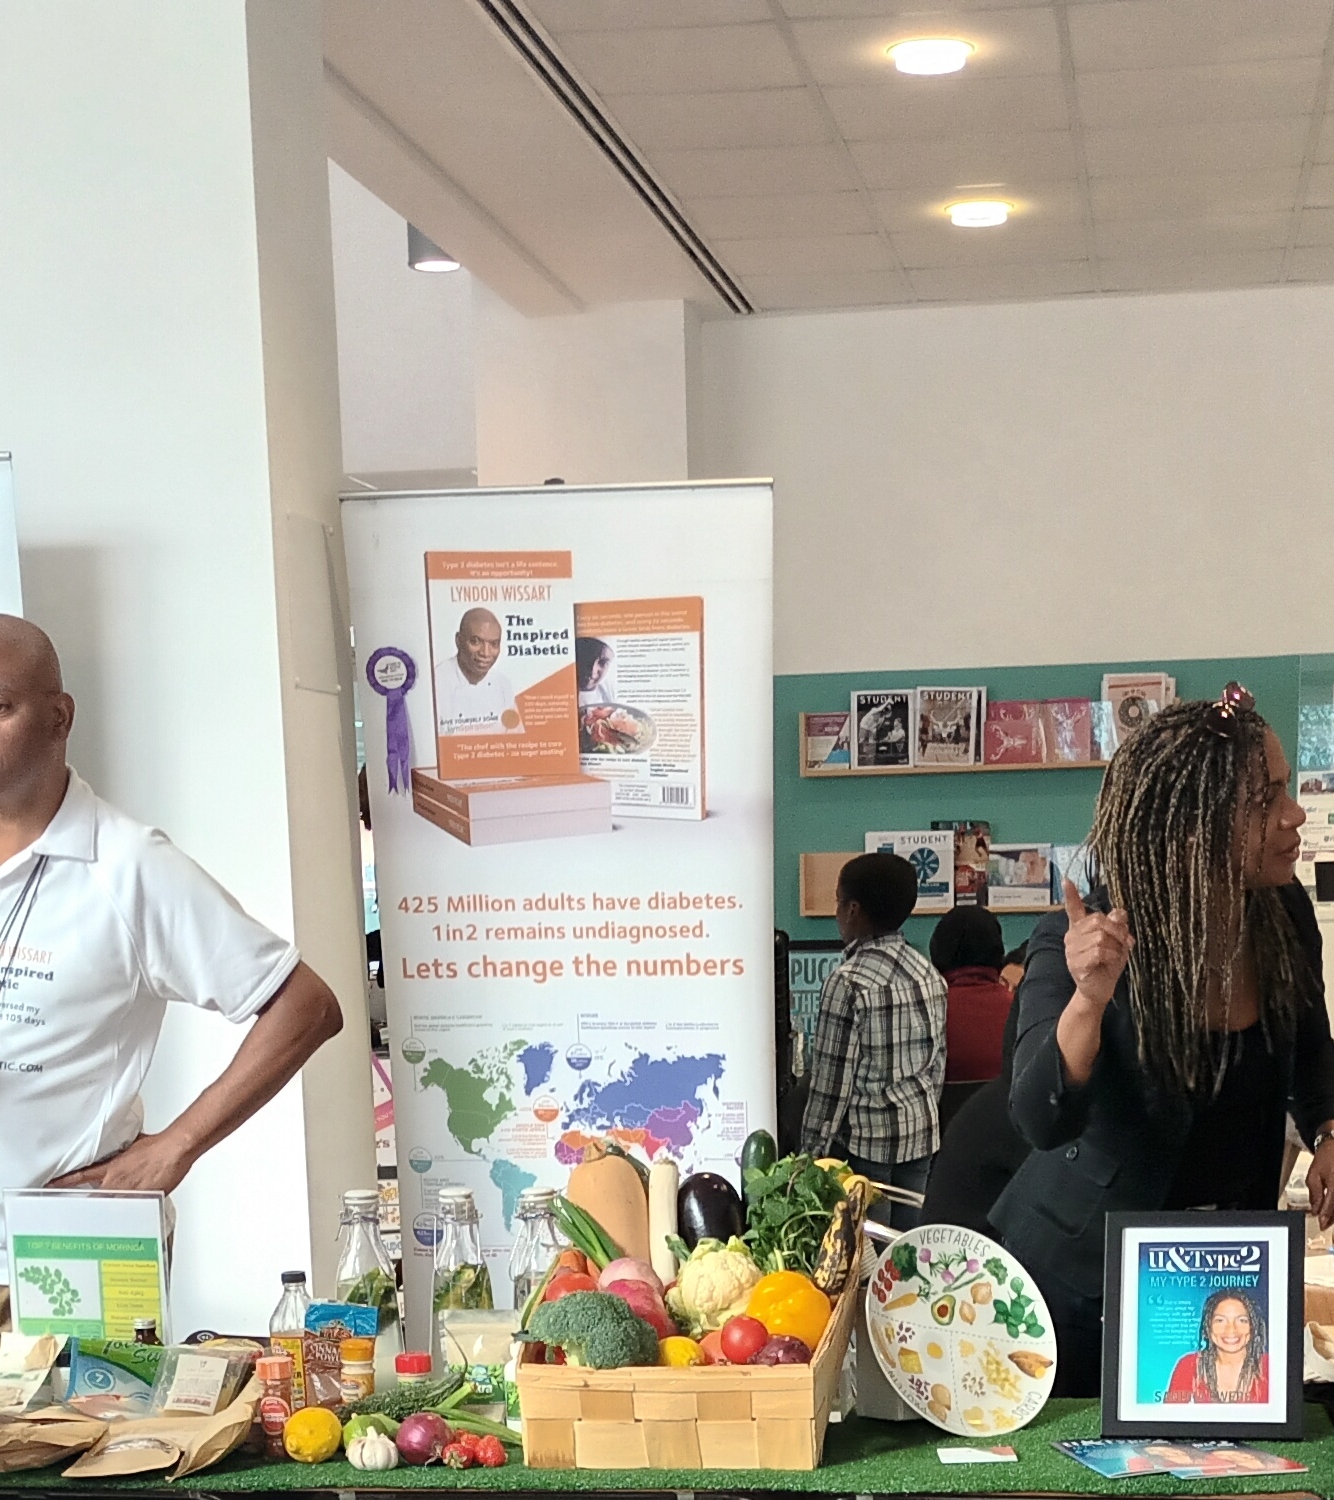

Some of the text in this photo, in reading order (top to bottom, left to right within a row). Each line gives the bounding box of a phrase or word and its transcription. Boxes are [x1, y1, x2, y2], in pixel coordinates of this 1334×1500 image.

[465, 561, 495, 569] diabetes
[450, 584, 553, 603] LYNDON WISSART
[505, 614, 534, 627] The
[506, 628, 570, 643] Inspired
[506, 645, 569, 657] Diabetic
[859, 694, 908, 705] STUDENT
[899, 834, 949, 846] STUDENT
[397, 890, 745, 915] 425 Million adults have diabetes.
[484, 921, 566, 942] remains
[572, 919, 711, 945] undiagnosed.
[400, 951, 746, 985] Lets change the numbers
[26, 1004, 42, 1016] my
[5, 1012, 47, 1026] 105 days
[52, 1242, 93, 1250] BENEFITS
[918, 1227, 992, 1258] VEGETABLES
[1149, 1274, 1260, 1288] MY TYPE 2 JOURNEY
[1011, 1390, 1043, 1422] CARBS
